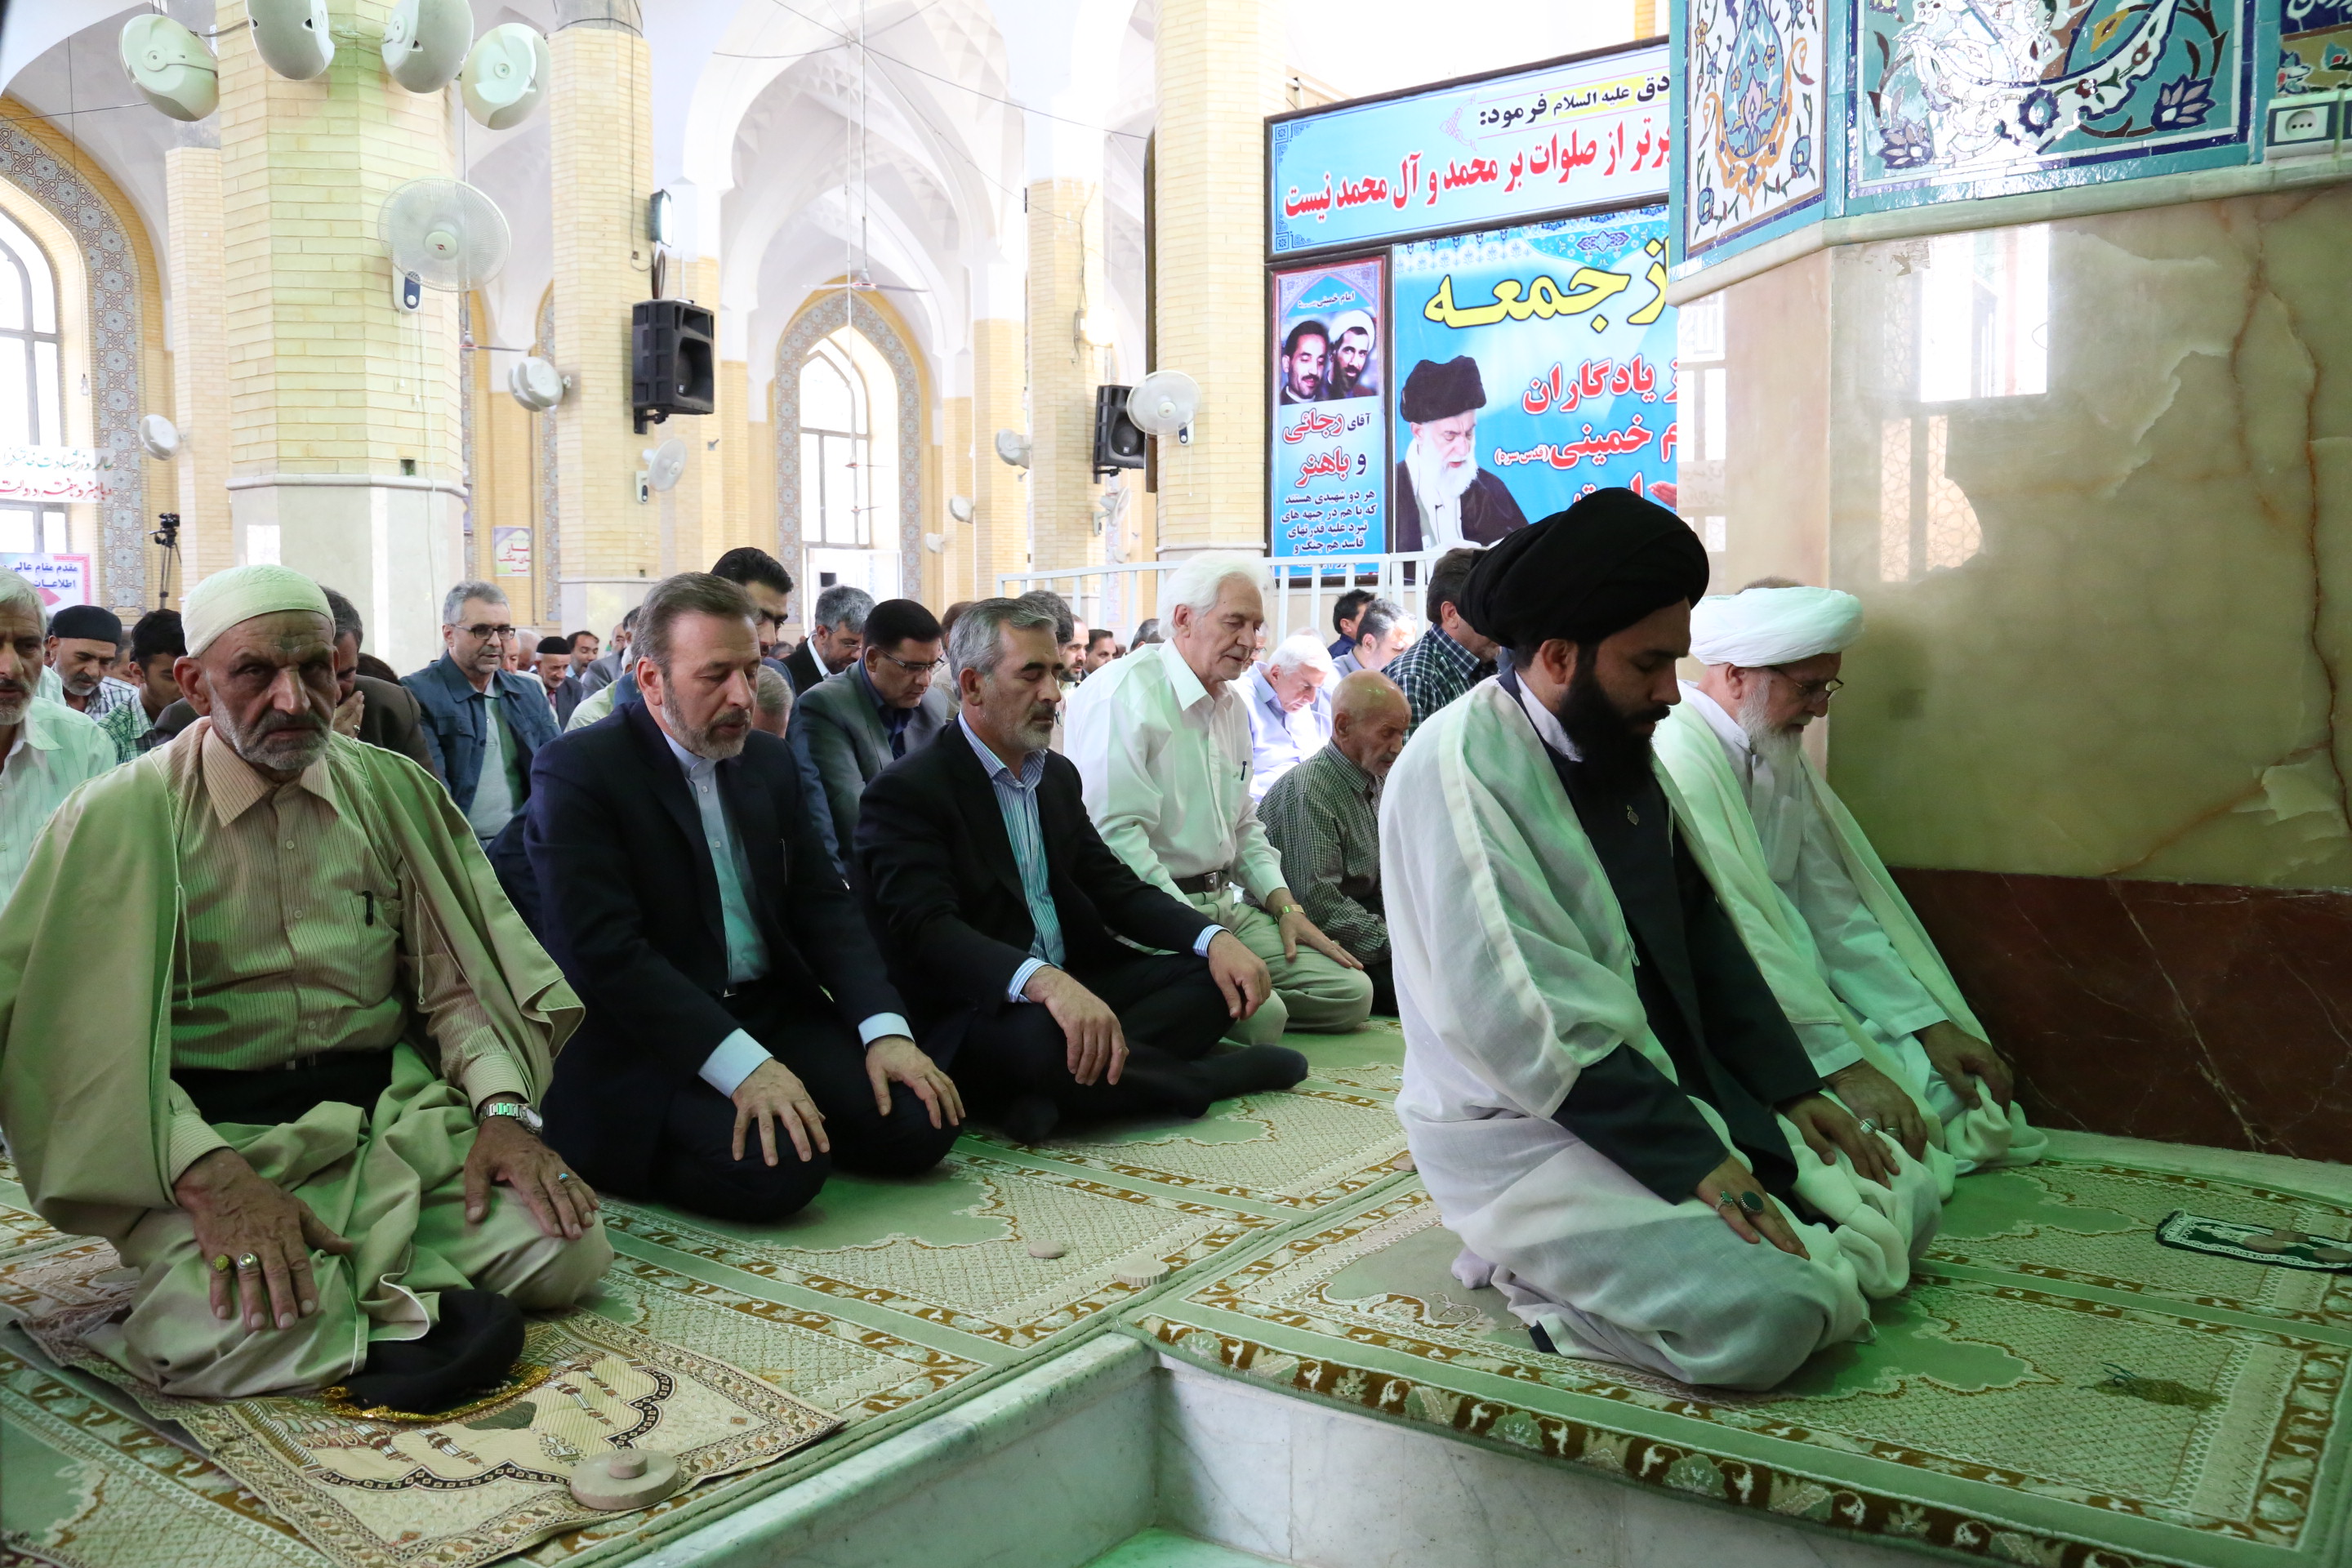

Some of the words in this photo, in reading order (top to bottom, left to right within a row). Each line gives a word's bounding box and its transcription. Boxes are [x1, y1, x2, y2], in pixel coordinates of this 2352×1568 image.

[1553, 91, 1597, 116] السلام
[1601, 86, 1630, 105] علیه
[1530, 128, 1597, 184] صلوات
[1603, 120, 1624, 176] از
[1393, 152, 1423, 209] آل
[1443, 158, 1499, 189] محمد
[1504, 151, 1523, 193] بر
[1285, 174, 1331, 221] نیست
[1336, 177, 1388, 207] محمد
[1426, 172, 1438, 206] و
[1423, 265, 1632, 333] جمعه
[1522, 354, 1657, 414] یادگاران
[1347, 412, 1371, 431] آقای
[1550, 413, 1654, 470] خمینی
[1294, 446, 1351, 488] باهنر
[1355, 453, 1366, 474] و
[1285, 495, 1312, 504] هستند
[1348, 491, 1360, 503] دو
[1363, 491, 1375, 502] هر
[1281, 510, 1299, 523] های
[1302, 510, 1323, 521] جبهه
[1326, 509, 1338, 520] در
[1340, 508, 1352, 519] هم
[1355, 506, 1362, 519] با
[1365, 504, 1377, 514] که
[1288, 522, 1325, 538] قدرتهای
[1327, 523, 1346, 537] علیه
[1348, 520, 1368, 535] نبرد
[1293, 543, 1300, 555] و
[1342, 536, 1364, 548] فاسد
